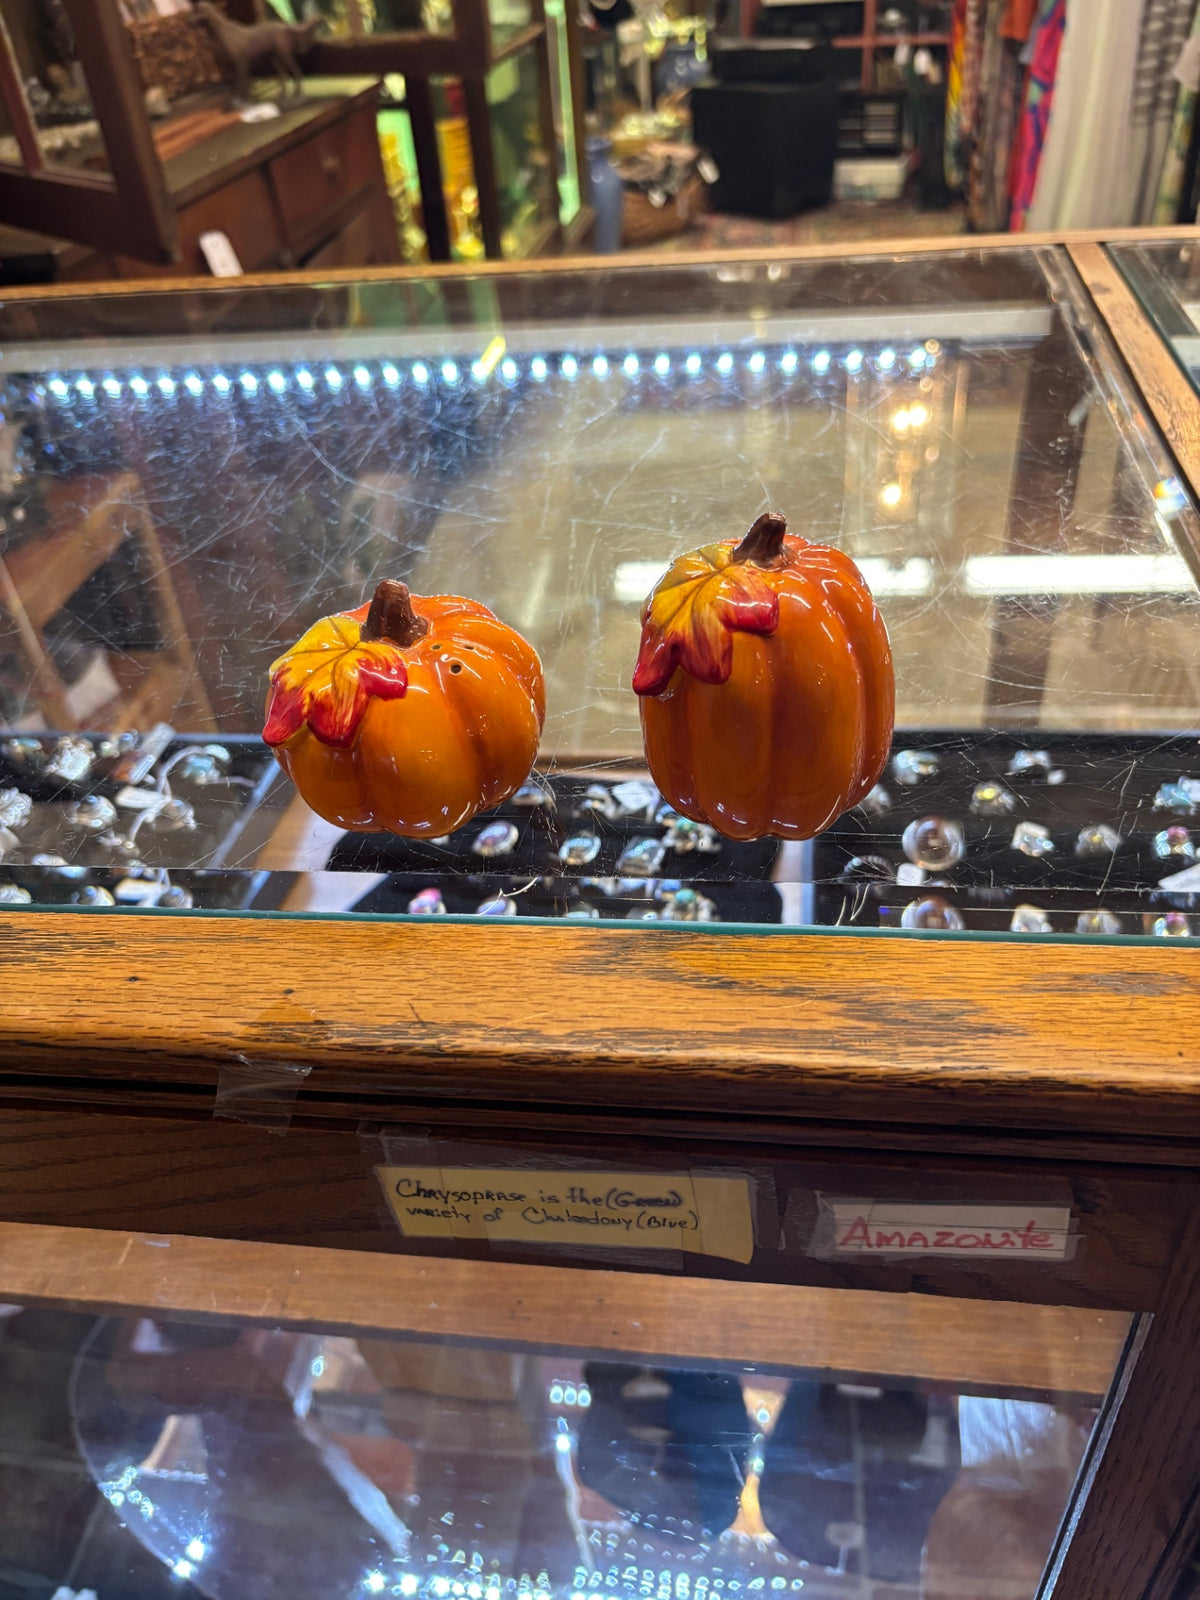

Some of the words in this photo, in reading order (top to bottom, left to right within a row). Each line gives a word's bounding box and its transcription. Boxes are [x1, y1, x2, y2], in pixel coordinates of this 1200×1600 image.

[538, 1190, 560, 1204] is
[566, 1187, 603, 1206] the
[483, 1207, 503, 1222] of
[637, 1210, 699, 1230] (Blue)
